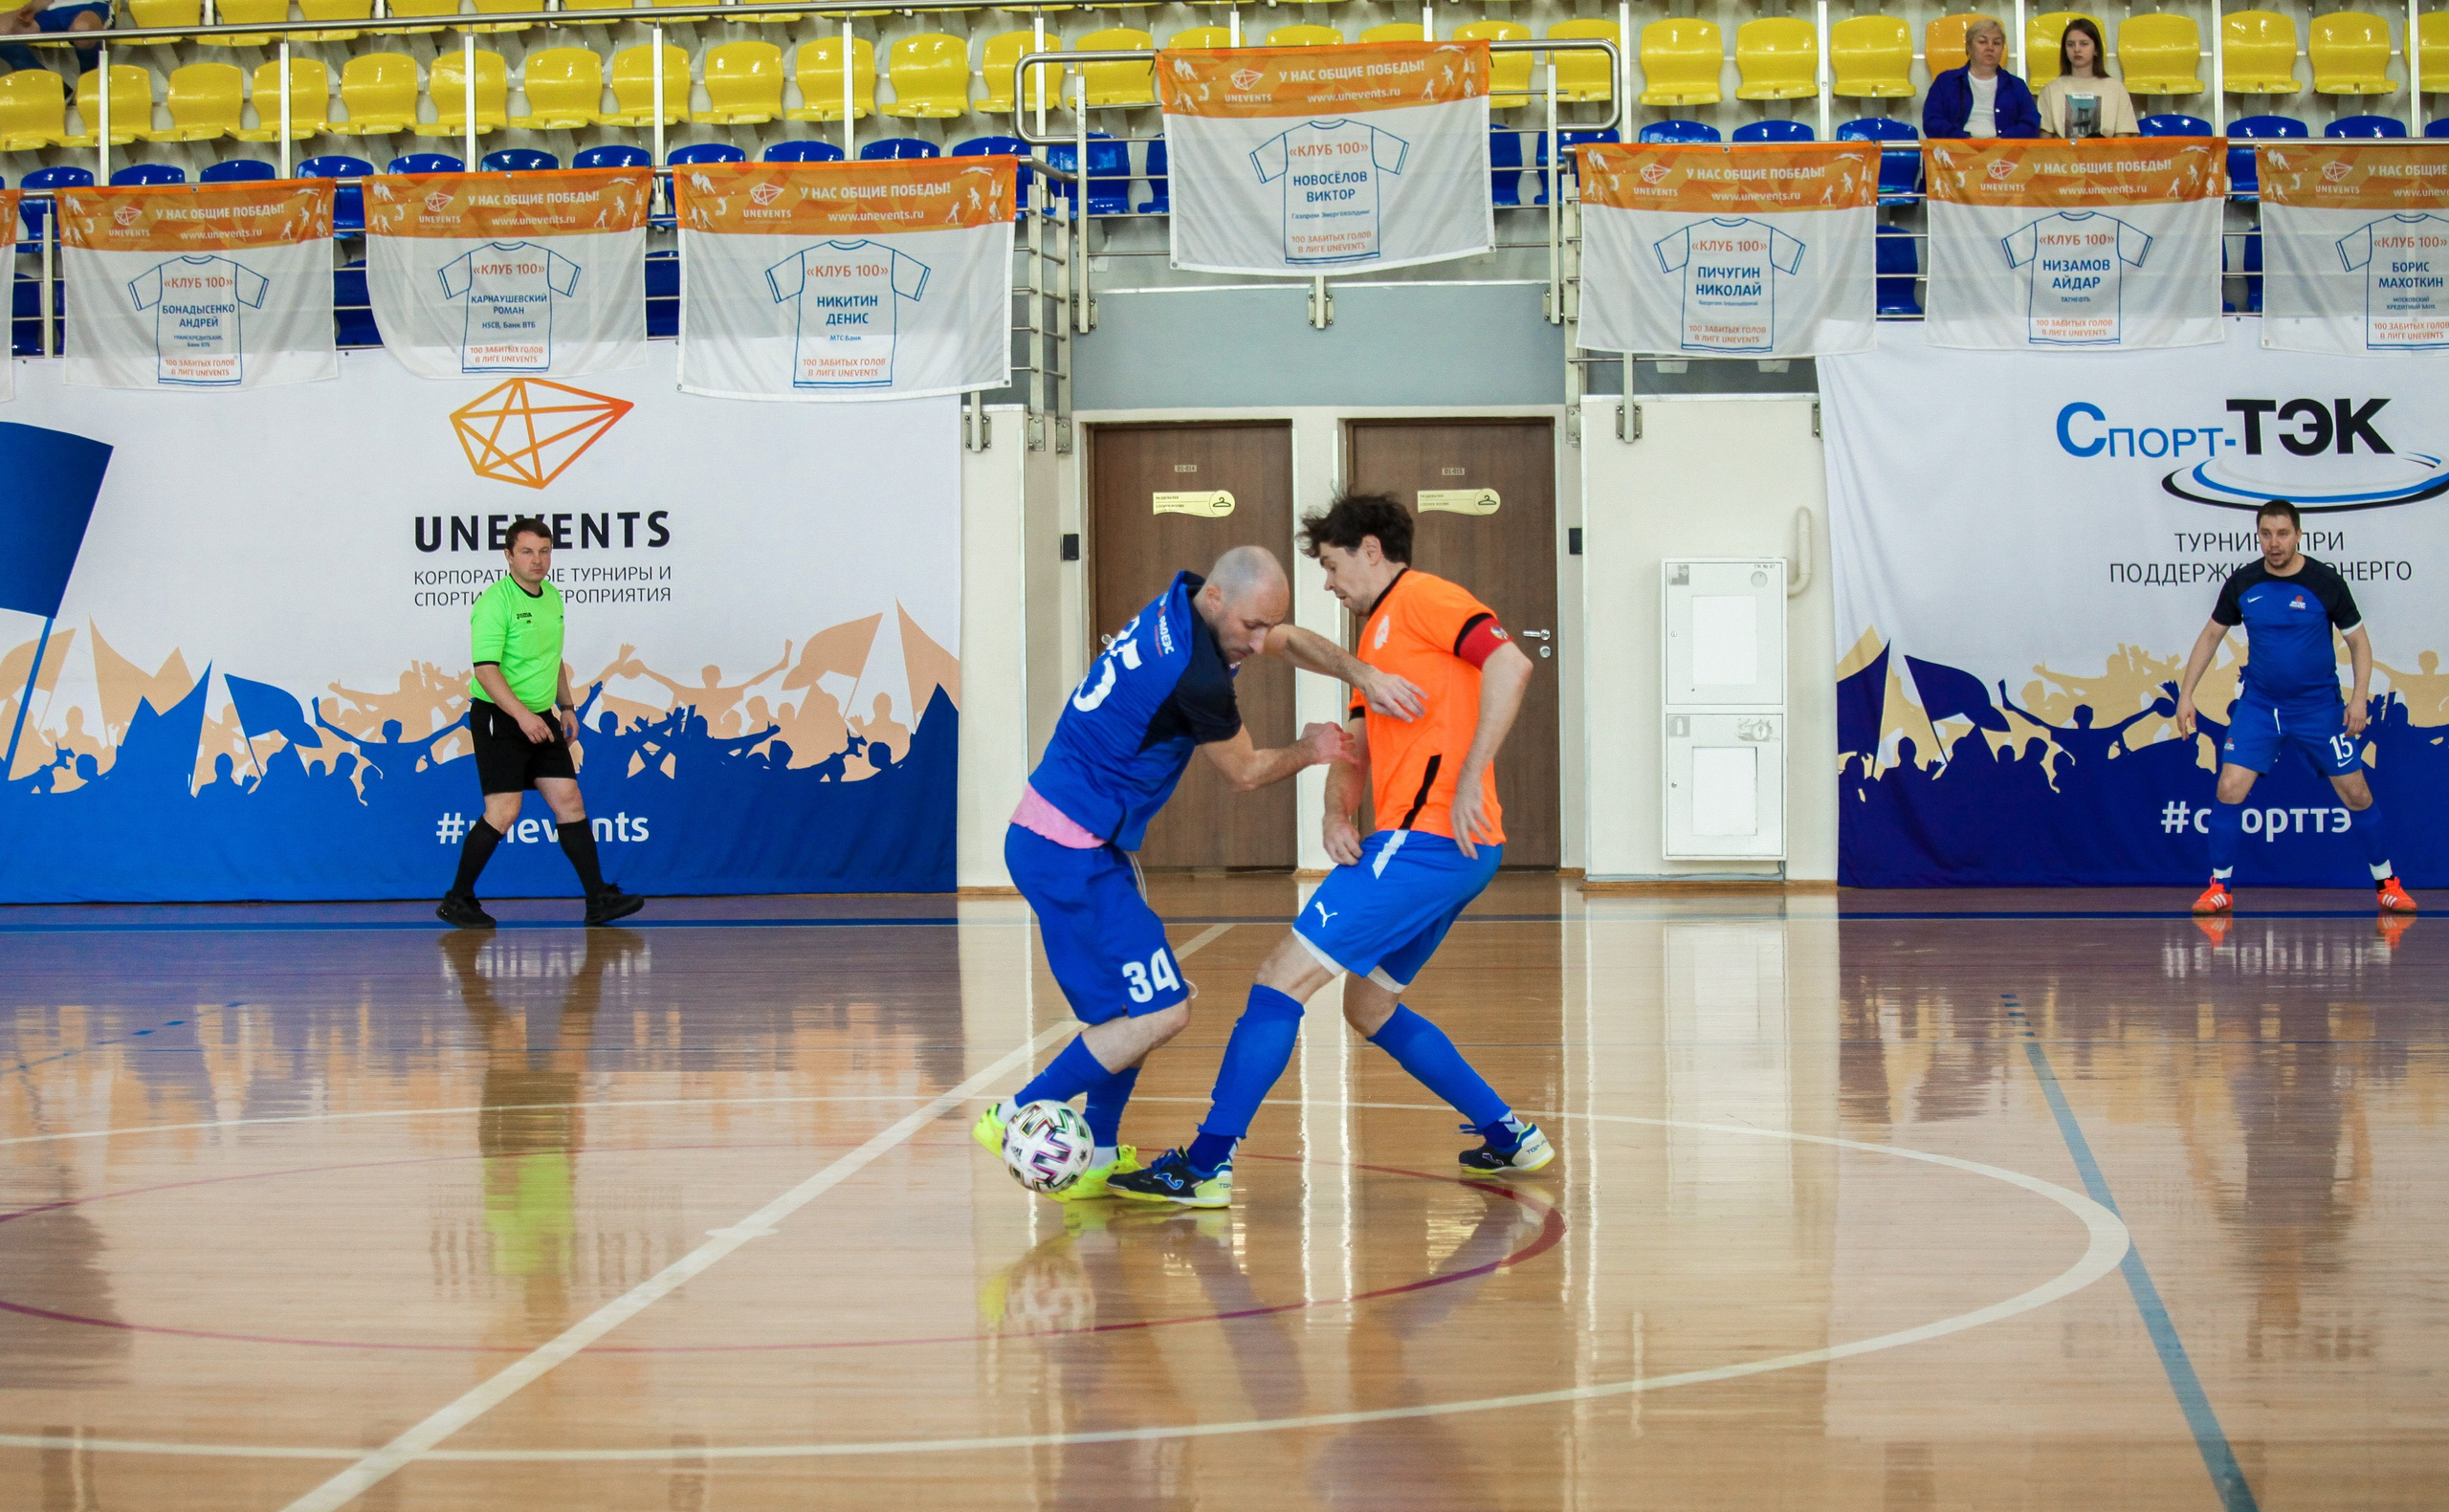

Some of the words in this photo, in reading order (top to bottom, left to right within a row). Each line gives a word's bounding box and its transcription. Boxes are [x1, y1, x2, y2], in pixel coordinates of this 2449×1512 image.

[1279, 72, 1287, 82] У
[1291, 70, 1315, 81] НАС
[1318, 68, 1363, 81] ОБЩИЕ
[1367, 61, 1424, 77] ПОБЕДЫ!
[1224, 94, 1271, 102] UNEVENTS
[1307, 88, 1400, 103] www.unevents.ru
[1290, 144, 1333, 157] «КЛУБ
[1336, 142, 1368, 155] 100»
[2034, 164, 2041, 174] У
[2044, 163, 2068, 173] НАС
[2071, 162, 2113, 175] ОБЩИЕ
[2117, 160, 2171, 173] ПОБЕДЫ!
[2368, 165, 2375, 176] У
[2379, 165, 2401, 175] НАС
[2405, 164, 2447, 176] ОБЩИЕ
[1293, 171, 1367, 186] НОВОСЁЛОВ
[1687, 168, 1693, 180] У
[1697, 168, 1720, 179] НАС
[1724, 168, 1767, 182] ОБЩИЕ
[1770, 166, 1825, 180] ПОБЕДЫ!
[801, 187, 807, 199] У
[812, 186, 837, 199] НАС
[841, 185, 887, 199] ОБЩИЕ
[891, 182, 950, 197] ПОБЕДЫ!
[1307, 189, 1356, 203] ВИКТОР
[1634, 187, 1678, 196] UNEVENTS
[1711, 191, 1800, 201] www.unevents.ru
[2059, 185, 2147, 196] www.unevents.ru
[2316, 186, 2360, 194] UNEVENTS
[469, 197, 474, 207] У
[478, 195, 500, 205] НАС
[503, 195, 543, 206] ОБЩИЕ
[547, 191, 599, 204] ПОБЕДЫ!
[156, 208, 163, 220] У
[165, 208, 188, 220] НАС
[190, 208, 230, 219] ОБЩИЕ
[233, 204, 283, 217] ПОБЕДЫ!
[743, 209, 791, 218] UNEVENTS
[828, 209, 923, 221] www.unevents.ru
[492, 216, 575, 226] www.unevents.ru
[181, 230, 262, 239] www.unevents.ru
[2040, 234, 2081, 246] «КЛУБ
[2085, 234, 2114, 245] 100»
[1327, 242, 1365, 252] UNEVENTS
[1691, 241, 1732, 252] «КЛУБ
[1737, 241, 1767, 252] 100»
[2373, 238, 2415, 248] «КЛУБ
[2418, 237, 2447, 247] 100»
[474, 264, 513, 275] «КЛУБ
[517, 264, 545, 274] 100»
[806, 266, 851, 277] «КЛУБ
[856, 265, 888, 276] 100»
[2042, 259, 2110, 272] НИЗАМОВ
[2393, 262, 2430, 272] БОРИС
[1698, 267, 1760, 278] ПИЧУГИН
[165, 278, 201, 288] «КЛУБ
[206, 277, 232, 288] 100»
[2053, 274, 2101, 290] АЙДАР
[2379, 277, 2443, 288] МАХОТКИН
[1696, 282, 1761, 296] НИКОЛАЙ
[471, 293, 546, 303] КАРНАУШЕВСКИЙ
[817, 296, 877, 307] НИКИТИН
[163, 304, 235, 316] БОНАДЫСЕНКО
[494, 305, 524, 315] РОМАН
[180, 315, 218, 328] АНДРЕЙ
[826, 313, 869, 326] ДЕНИС
[415, 511, 670, 553] UNEENTS
[2297, 532, 2344, 551] ПРИ
[571, 566, 651, 581] ТУРНИРЫ
[660, 566, 671, 580] И
[2329, 733, 2353, 759] 15
[1122, 948, 1180, 1002] 34
